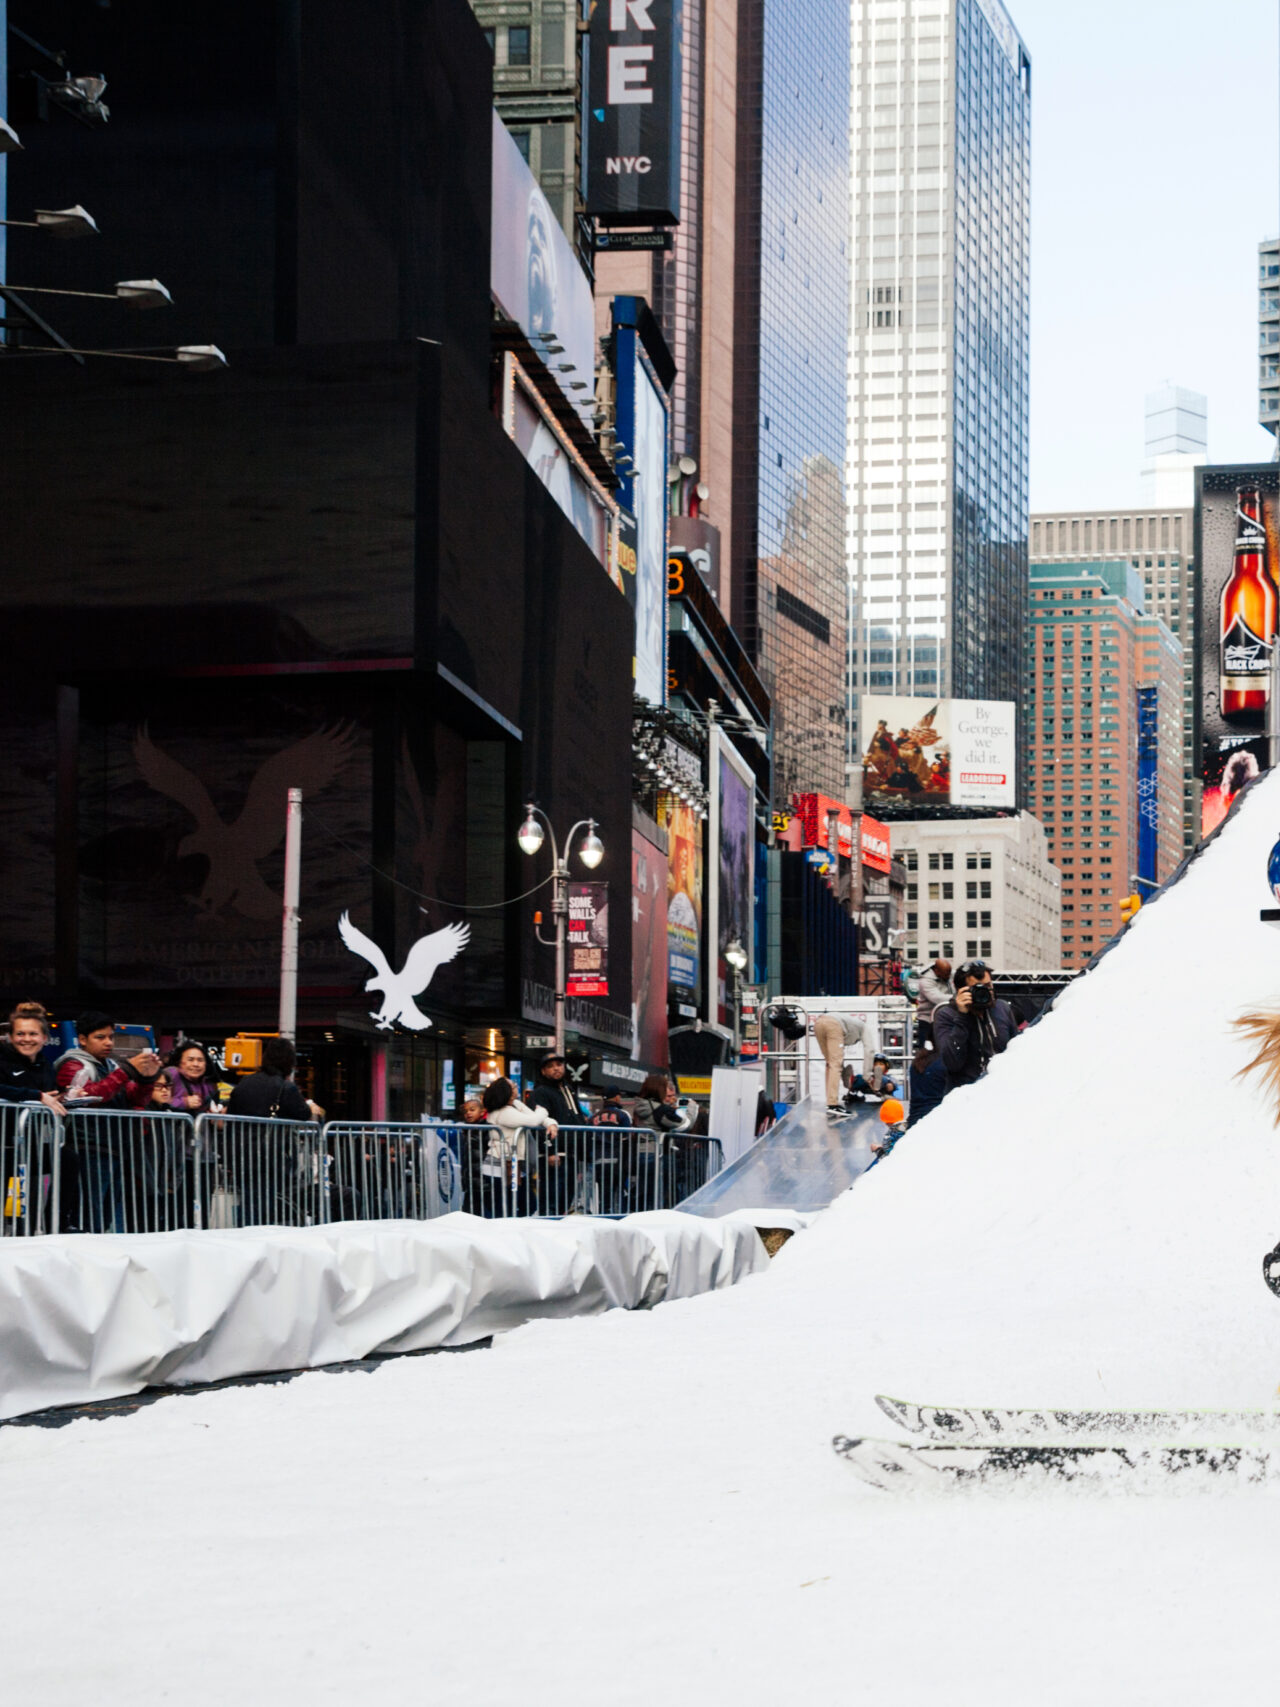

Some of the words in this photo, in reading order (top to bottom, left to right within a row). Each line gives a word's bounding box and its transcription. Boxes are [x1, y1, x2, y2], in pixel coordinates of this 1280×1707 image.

[606, 156, 651, 175] NYC
[976, 706, 991, 722] By
[958, 721, 1008, 738] George,
[974, 738, 992, 749] we
[965, 750, 985, 764] did
[568, 896, 593, 908] SOME
[568, 908, 597, 920] WALLS
[568, 920, 586, 931] CAN
[568, 931, 589, 943] TALK
